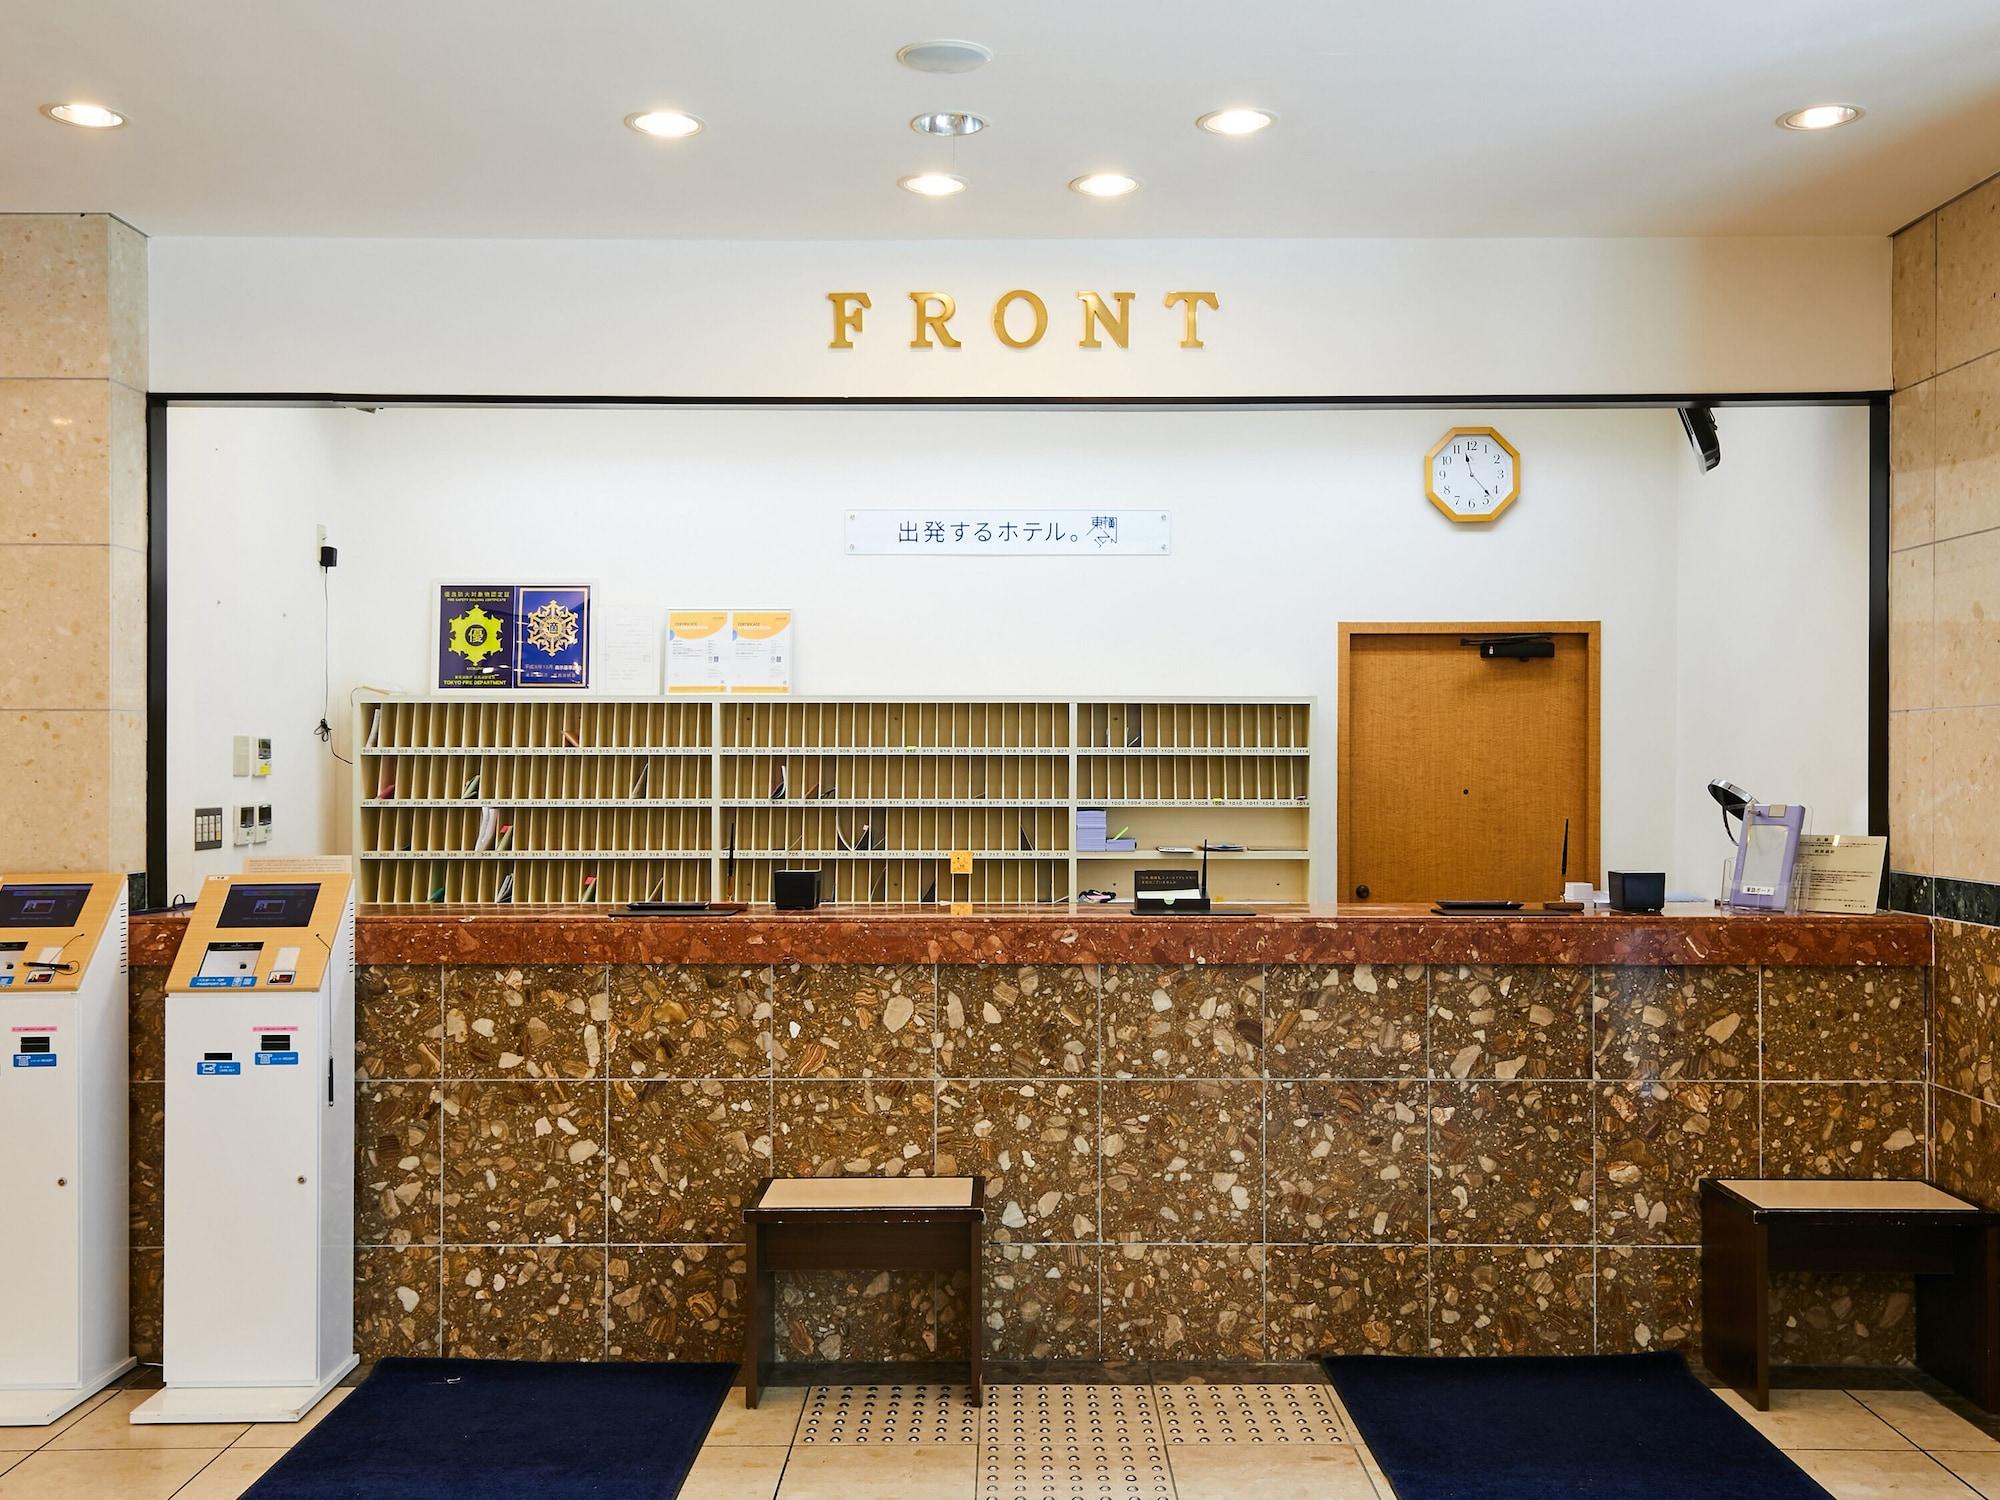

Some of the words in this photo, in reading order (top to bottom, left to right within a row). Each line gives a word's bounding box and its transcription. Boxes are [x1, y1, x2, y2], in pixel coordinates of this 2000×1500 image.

[826, 289, 1220, 349] FRONT
[1453, 445, 1460, 454] 11
[1467, 441, 1478, 451] 12
[1442, 456, 1452, 465] 10
[1494, 454, 1501, 464] 2
[1439, 470, 1446, 480] 9
[1497, 470, 1504, 480] 3
[1443, 485, 1451, 495] 8
[1454, 496, 1461, 505] 7
[1468, 499, 1476, 509] 6
[898, 520, 1079, 543] 出発するホテル。
[468, 627, 484, 643] 優
